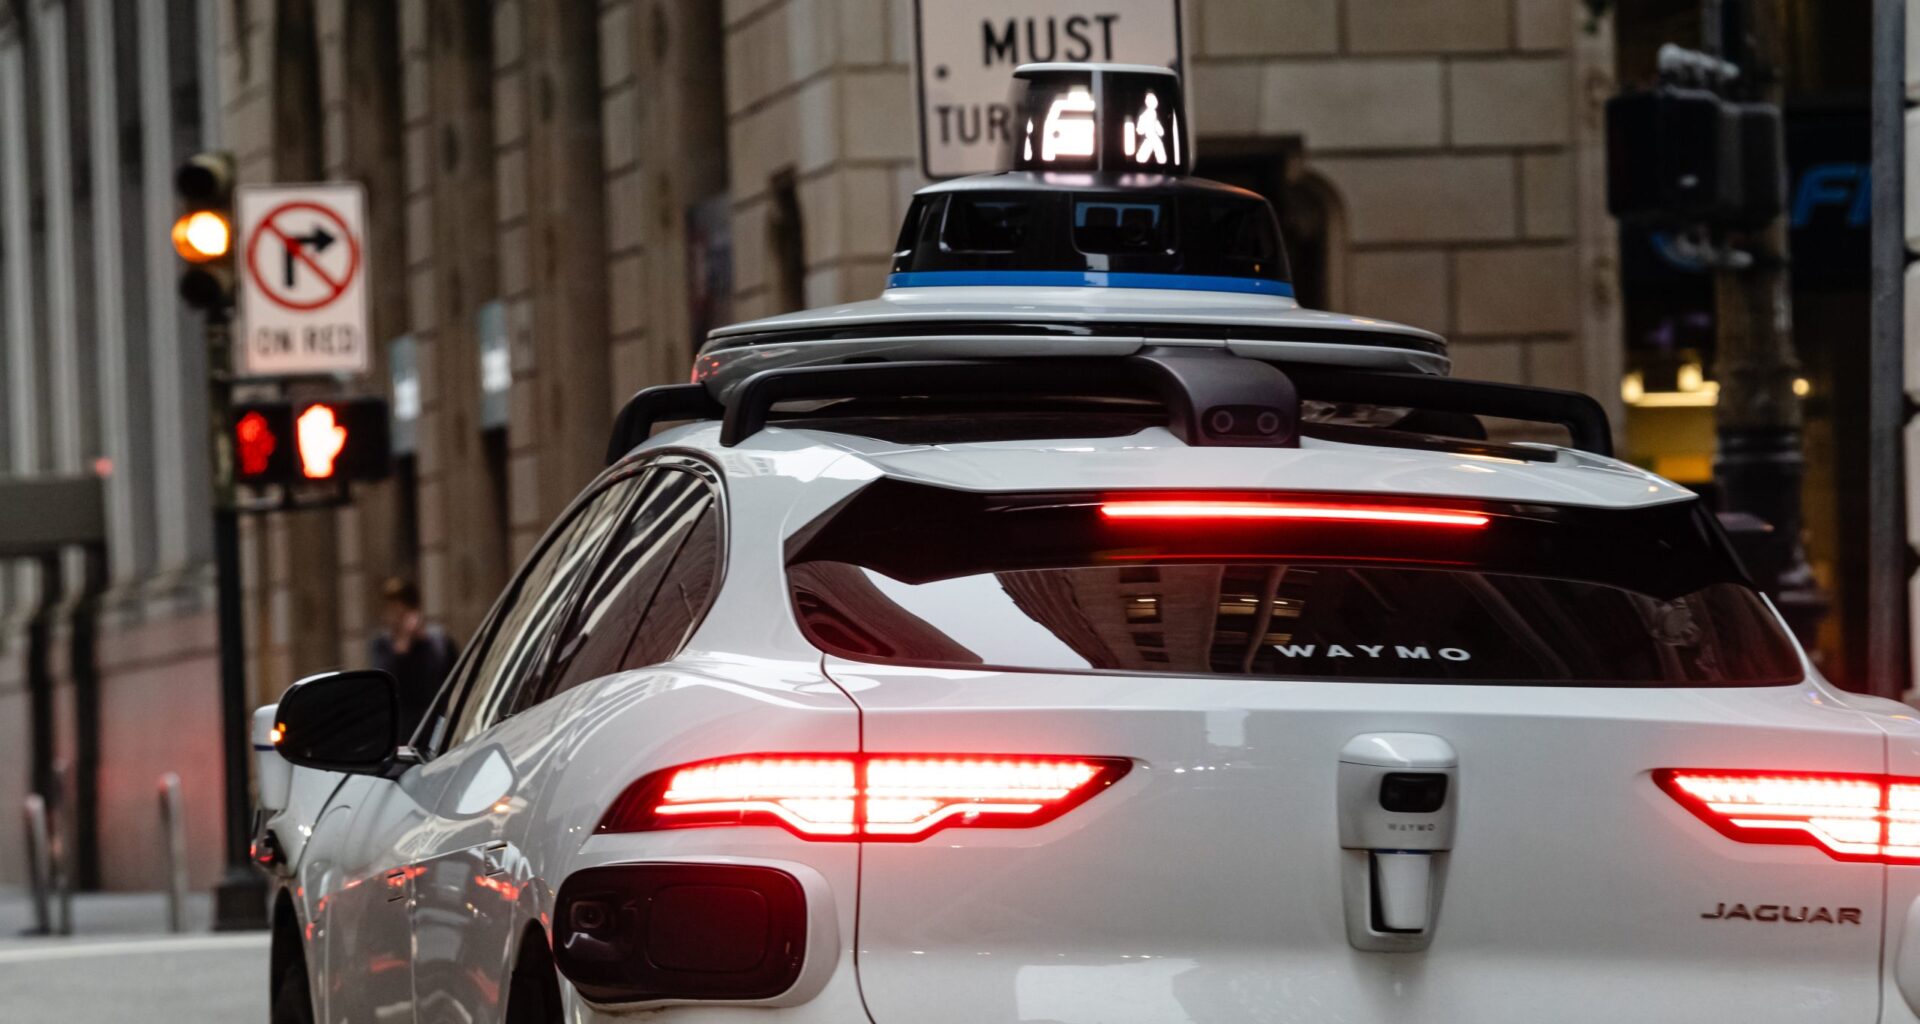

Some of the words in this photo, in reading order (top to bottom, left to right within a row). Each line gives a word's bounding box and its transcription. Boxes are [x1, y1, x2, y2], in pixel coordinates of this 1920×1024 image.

[982, 14, 1119, 66] MUST
[935, 104, 1016, 146] TUR
[257, 326, 294, 356] ON
[302, 323, 355, 354] RED
[1273, 644, 1471, 662] WAYMO
[1386, 822, 1436, 832] WAYMO
[1700, 902, 1862, 925] JAGUAR
